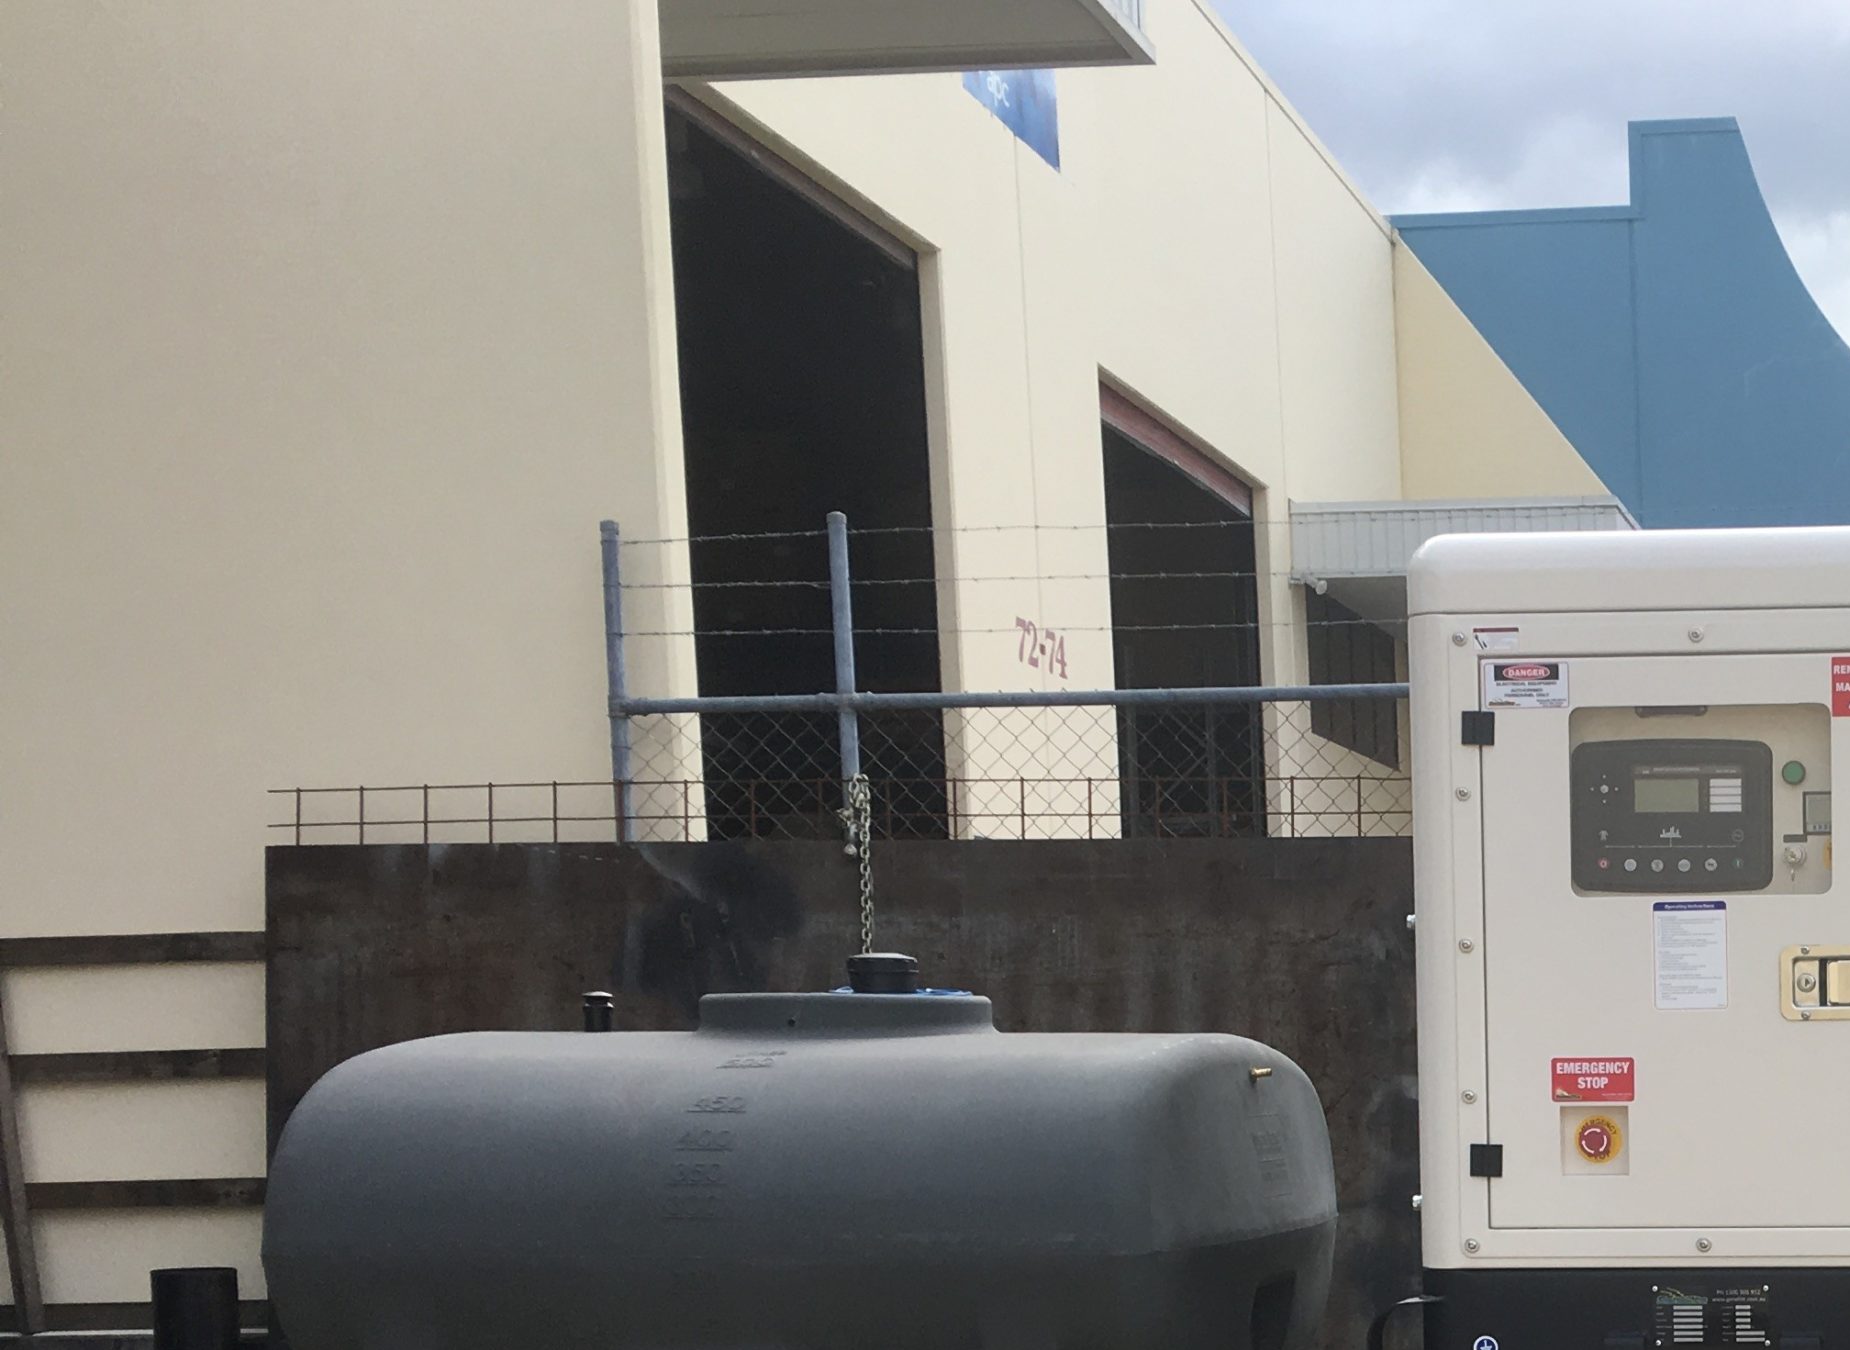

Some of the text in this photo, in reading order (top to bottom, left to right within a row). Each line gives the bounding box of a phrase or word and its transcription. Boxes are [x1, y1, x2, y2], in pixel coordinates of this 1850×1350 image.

[1016, 616, 1067, 680] 72-74
[1508, 668, 1545, 677] DANGER
[1556, 1062, 1630, 1074] EMERGENCY
[1577, 1076, 1609, 1089] STOP
